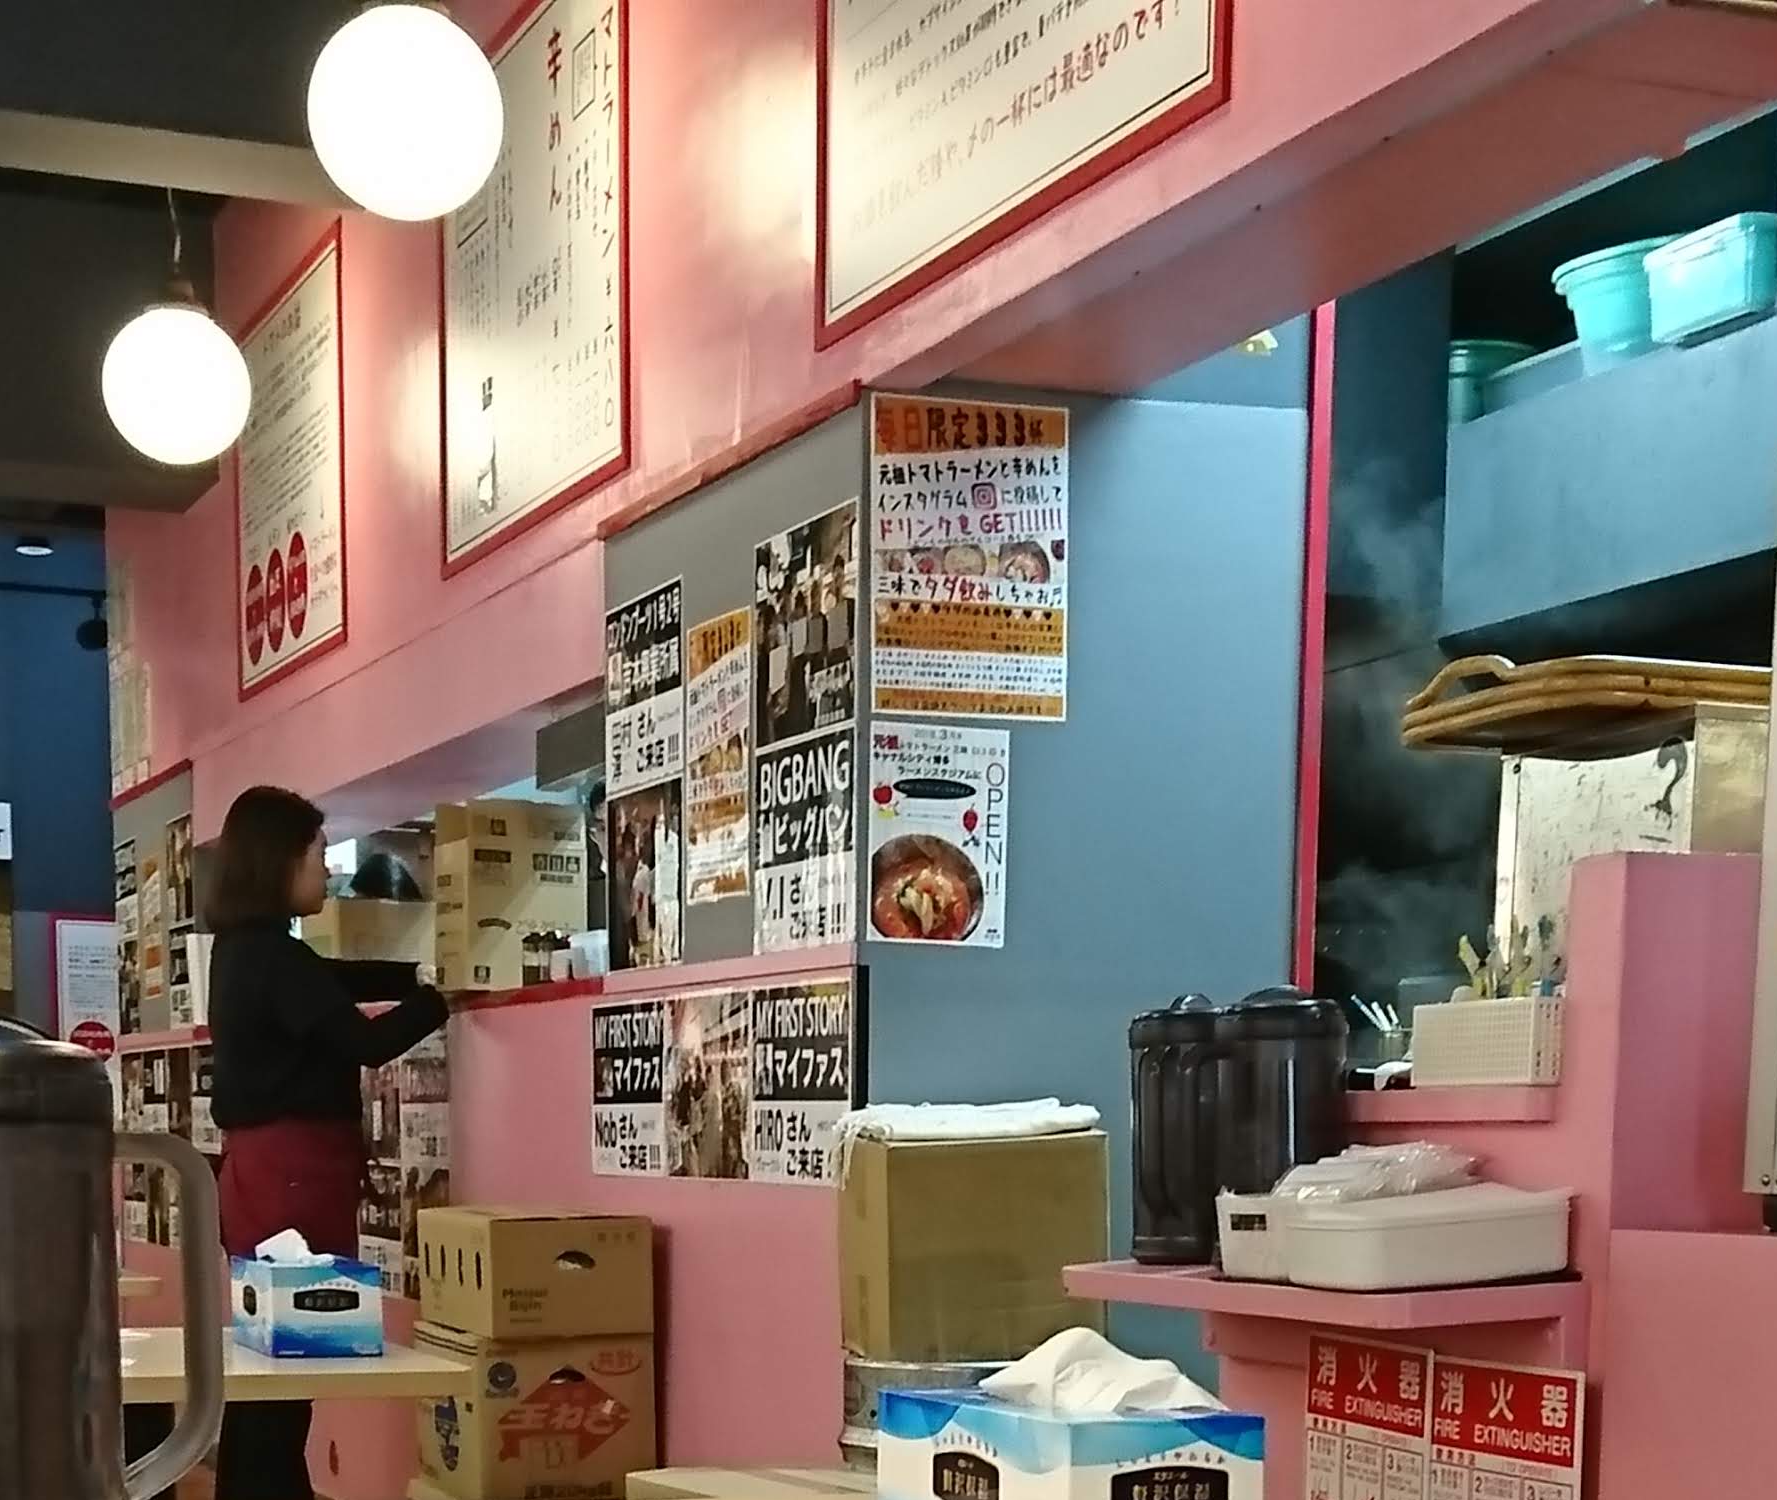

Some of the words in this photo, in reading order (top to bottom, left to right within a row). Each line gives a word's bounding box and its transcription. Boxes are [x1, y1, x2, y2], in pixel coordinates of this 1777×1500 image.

[548, 27, 562, 213] 辛めん
[879, 455, 1062, 486] 元祖トマトラーメンと辛めんを
[878, 489, 968, 512] インスタグラム
[880, 513, 972, 541] ドリンクを
[637, 706, 657, 740] さん
[760, 739, 851, 811] BIGBANG
[774, 997, 805, 1039] FIRST
[806, 994, 847, 1038] STORY
[613, 1055, 661, 1093] マイファス
[774, 1046, 844, 1090] マイファス
[594, 1111, 617, 1149] Nob
[618, 1112, 638, 1140] さん
[755, 1108, 784, 1152] HIRO
[786, 1110, 812, 1143] さん
[1317, 1345, 1420, 1401] 消火器
[1311, 1388, 1335, 1410] FIRE
[1344, 1395, 1423, 1429] EXTINGUISHER
[1440, 1371, 1569, 1429] 消火器
[1434, 1417, 1461, 1441] FIRE
[1474, 1423, 1572, 1457] EXTINGUISHER
[1475, 1476, 1483, 1493] 2
